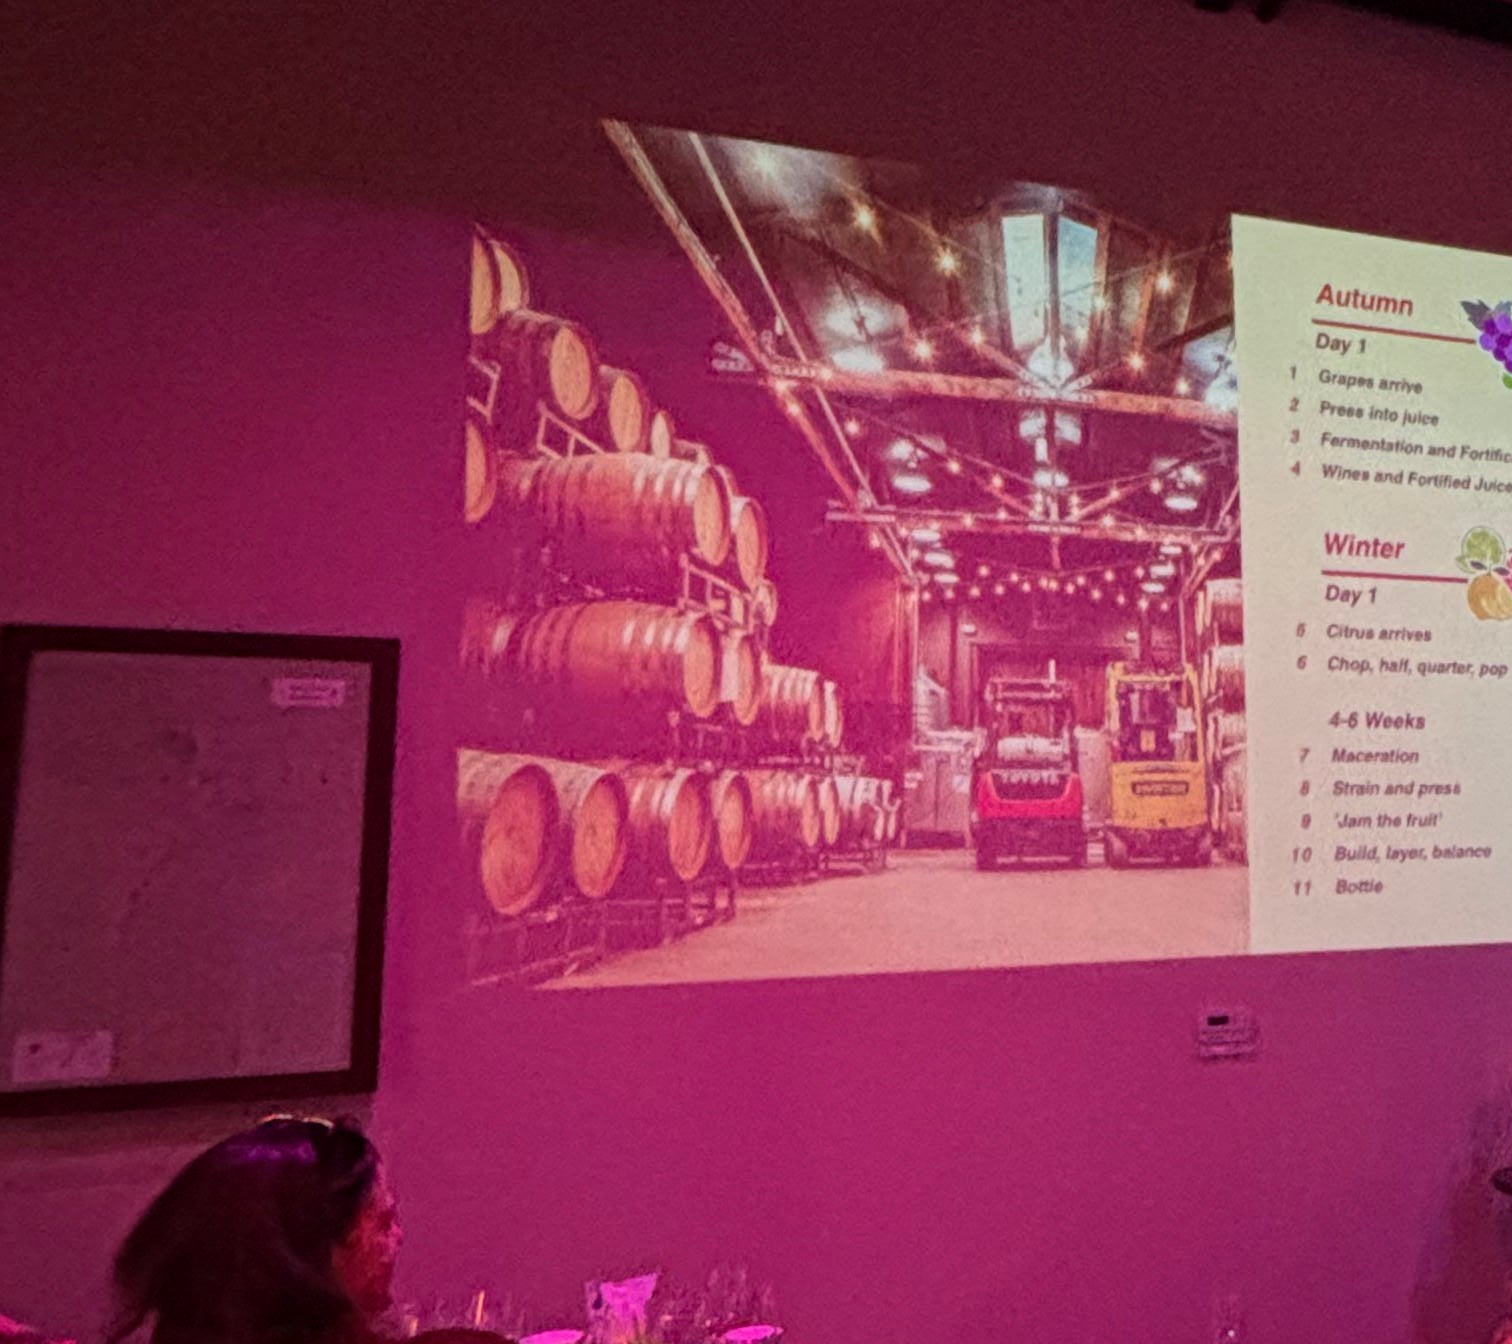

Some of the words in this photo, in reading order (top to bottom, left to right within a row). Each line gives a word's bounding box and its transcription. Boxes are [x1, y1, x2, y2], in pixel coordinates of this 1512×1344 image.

[1315, 283, 1414, 316] Autumn
[1315, 332, 1352, 355] Day
[1358, 338, 1367, 354] 1
[1289, 366, 1298, 380] 1
[1318, 368, 1374, 393] Grapes
[1378, 378, 1423, 394] arrive
[1289, 398, 1300, 412] 2
[1319, 400, 1364, 419] Press
[1369, 408, 1398, 423] into
[1402, 410, 1440, 427] juice
[1289, 430, 1300, 444] 3
[1320, 432, 1424, 456] Fermentation
[1427, 444, 1456, 459] and
[1290, 461, 1301, 476] 4
[1322, 463, 1370, 482] Wines
[1374, 470, 1403, 486] and
[1407, 472, 1471, 491] Fortified
[1324, 531, 1406, 560] Winter
[1325, 584, 1361, 607] Day
[1368, 587, 1377, 604] 1
[1326, 623, 1375, 641] Citrus
[1378, 627, 1433, 643] arrives
[1296, 655, 1307, 670] 6
[1327, 655, 1374, 673] Chop,
[1379, 657, 1412, 675] half,
[1416, 661, 1475, 677] quarter,
[1478, 662, 1509, 679] pop
[1328, 711, 1358, 729] 4-6
[1365, 712, 1426, 730] Weeks
[1299, 748, 1310, 763] 7
[1331, 748, 1420, 764] Maceration
[1299, 780, 1310, 796] 8
[1332, 780, 1380, 796] Strain
[1384, 781, 1414, 796] and
[1417, 782, 1462, 799] press
[1301, 813, 1312, 829] 9
[1376, 812, 1402, 828] the
[1292, 847, 1312, 863] 10
[1334, 846, 1381, 863] Build,
[1385, 845, 1428, 864] layer,
[1431, 844, 1492, 860] balance
[1293, 880, 1312, 896] 11
[1335, 878, 1384, 895] Bottle
